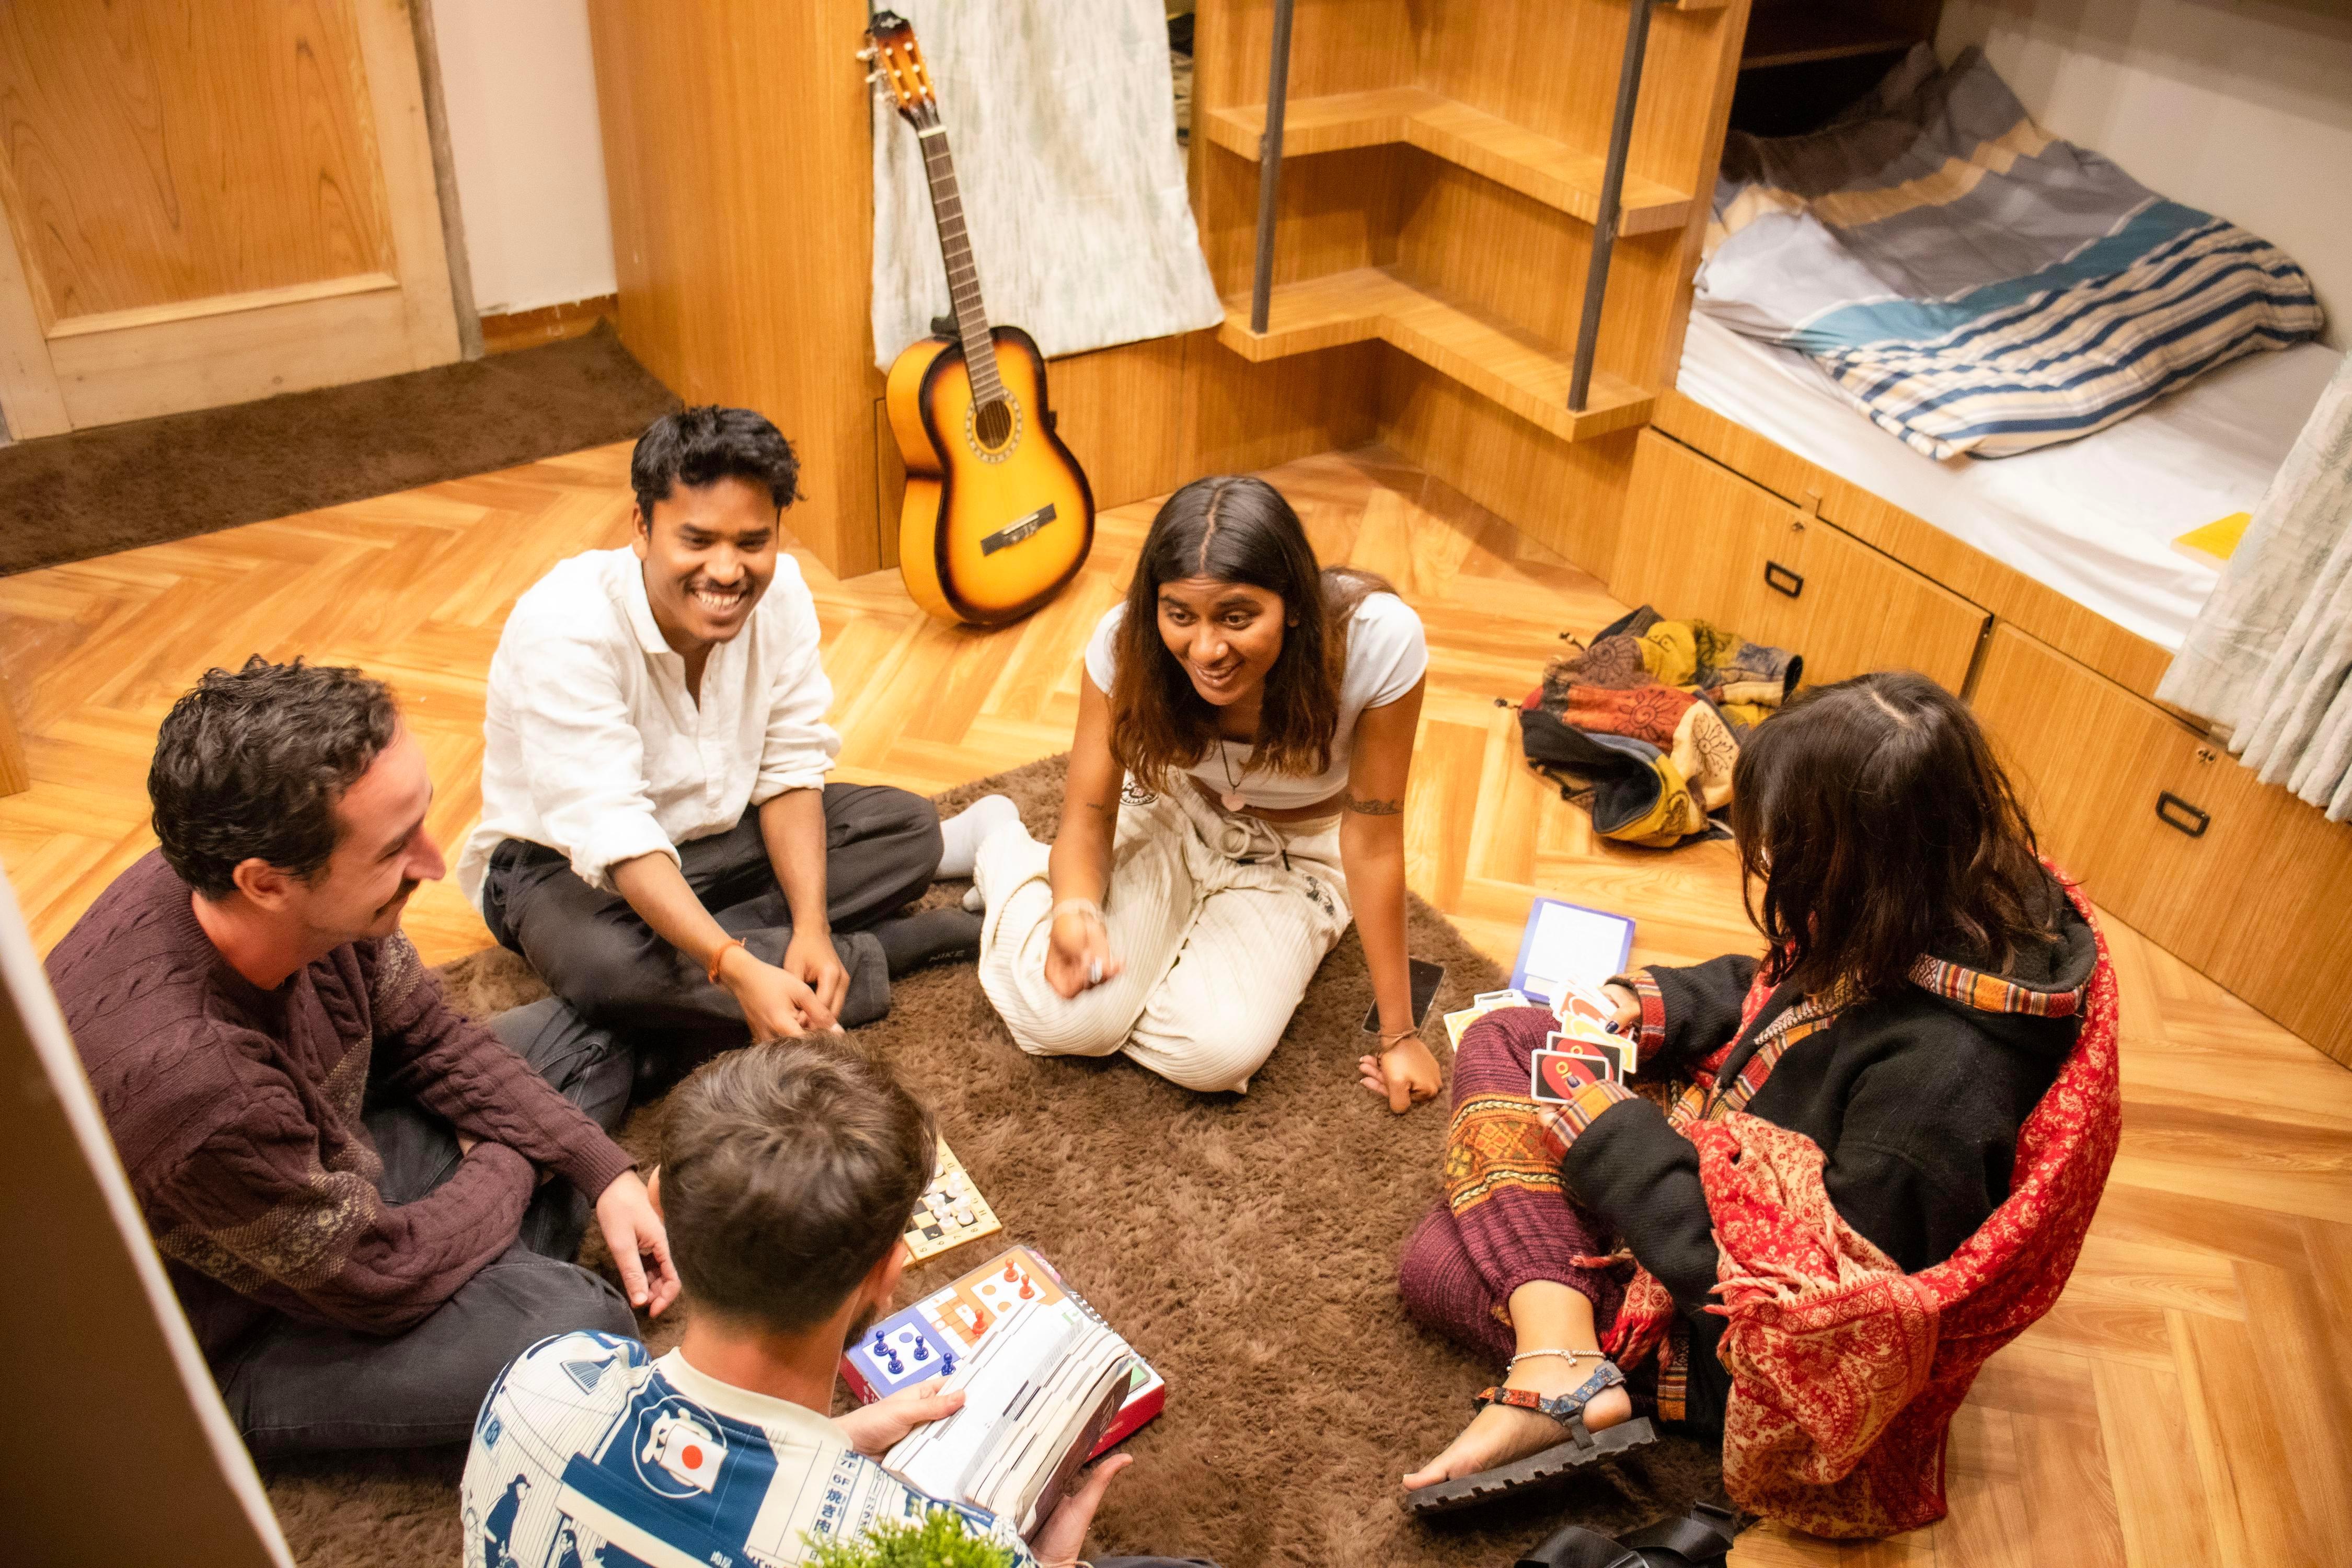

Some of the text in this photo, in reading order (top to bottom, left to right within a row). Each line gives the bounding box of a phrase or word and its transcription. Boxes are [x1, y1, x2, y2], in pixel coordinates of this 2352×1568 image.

[840, 1459, 857, 1469] 7F
[833, 1474, 850, 1485] 6F
[814, 1488, 842, 1534] 焼き肉
